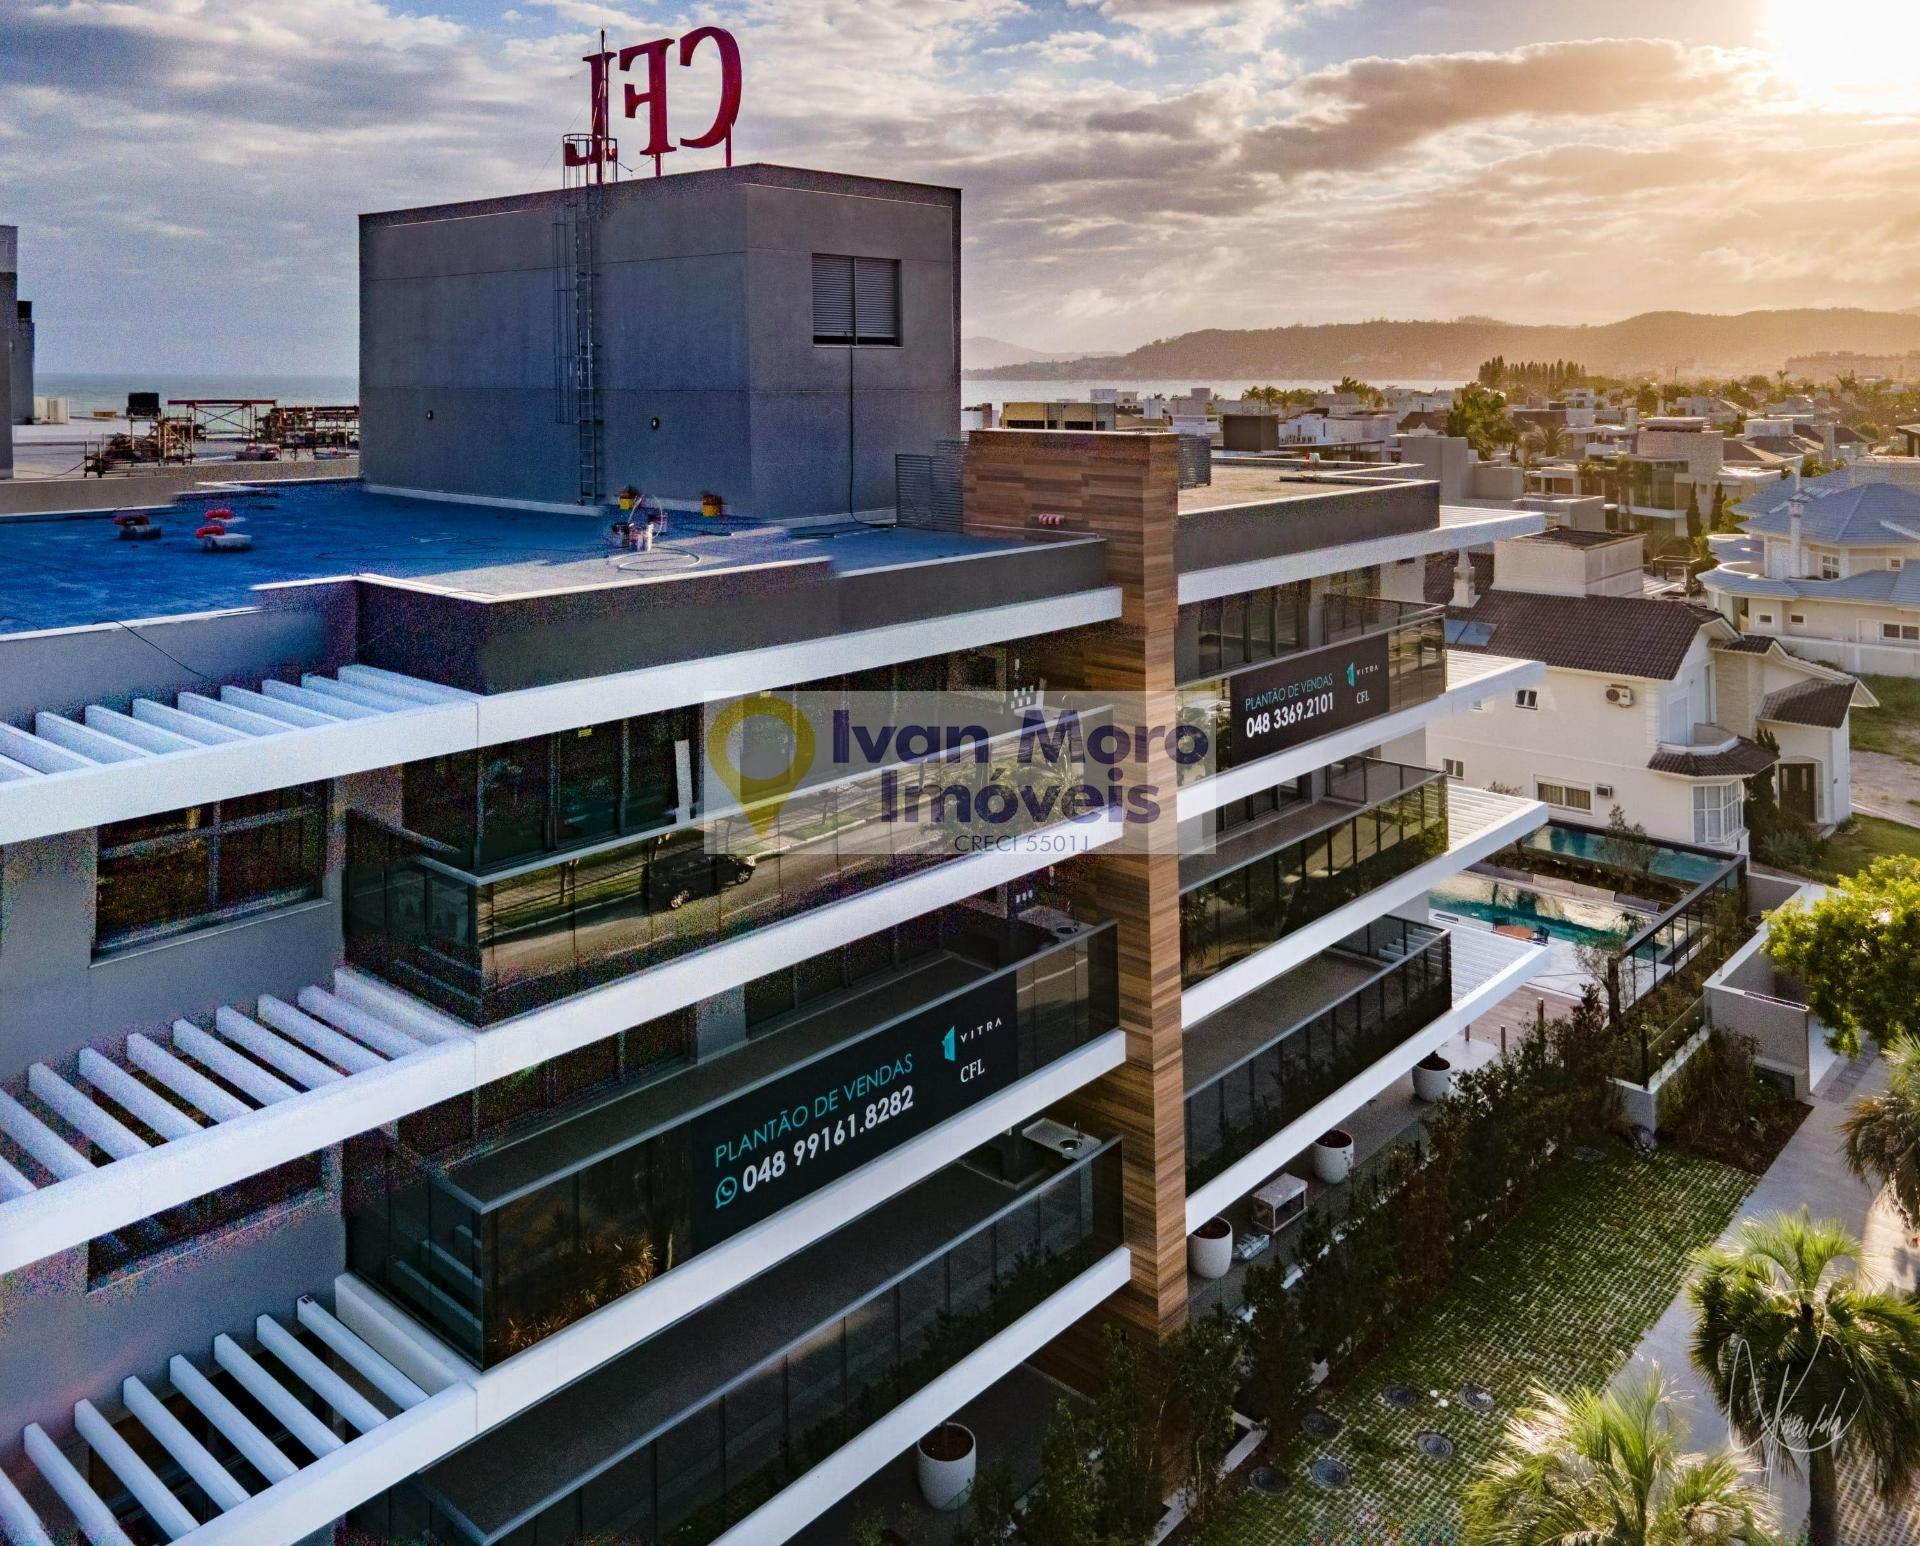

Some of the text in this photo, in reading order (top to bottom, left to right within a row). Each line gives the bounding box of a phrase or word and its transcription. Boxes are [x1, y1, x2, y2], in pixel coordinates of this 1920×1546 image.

[1356, 665, 1378, 676] VITRA
[1245, 674, 1333, 711] PLANTÃO DE VENDAS
[1356, 690, 1370, 704] CFL
[1246, 692, 1333, 737] 048 3369.2101
[960, 1017, 1003, 1043] VITRA
[960, 1059, 985, 1083] CFL
[715, 1053, 913, 1168] PLANTÃO DE VENDAS
[742, 1085, 914, 1193] 048 99161.8282
